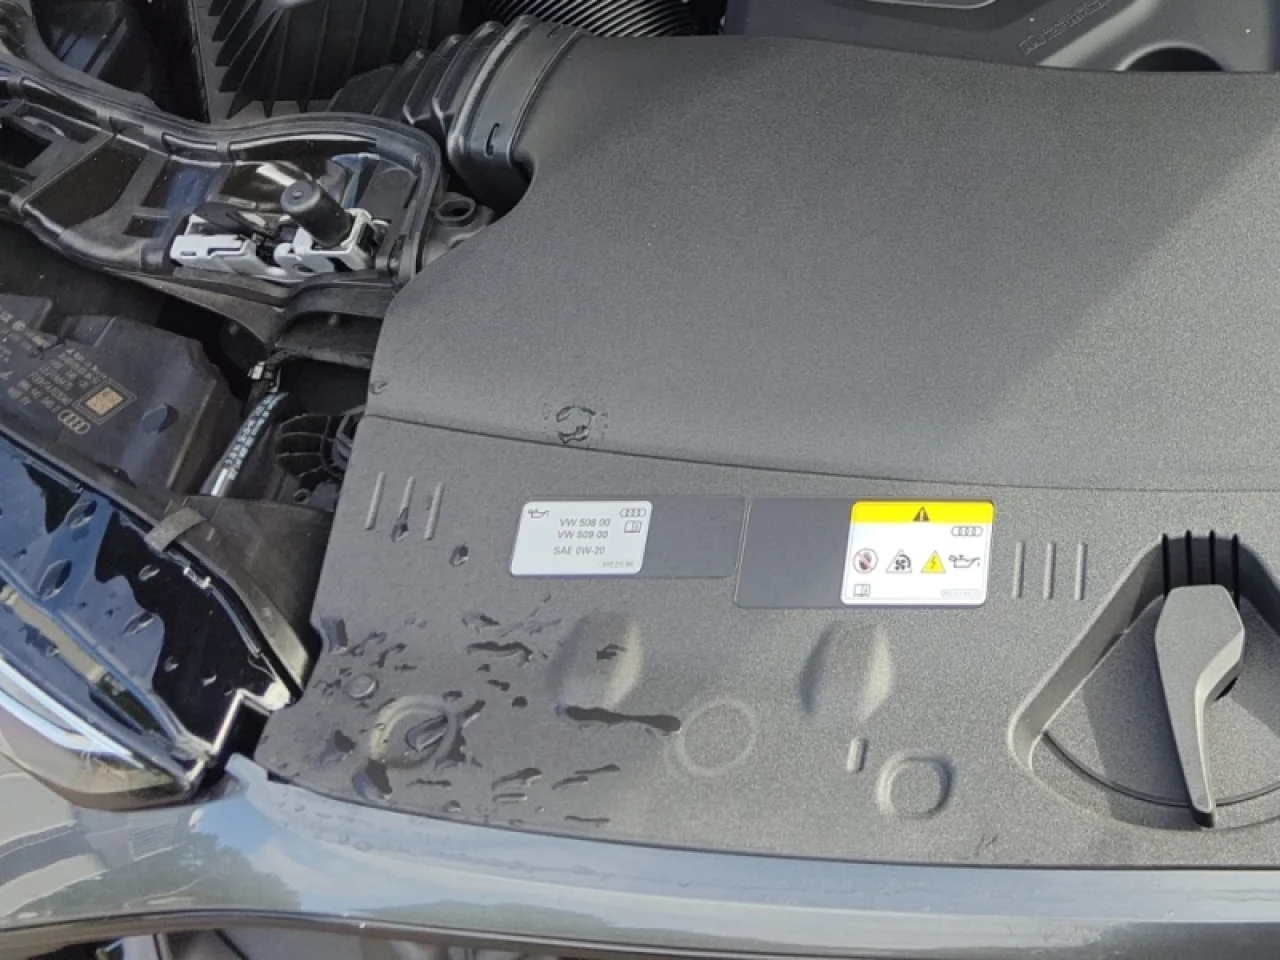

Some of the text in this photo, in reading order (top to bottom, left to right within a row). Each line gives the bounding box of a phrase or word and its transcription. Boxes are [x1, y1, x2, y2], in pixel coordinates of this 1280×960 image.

[559, 518, 611, 527] VW 508 00
[557, 530, 609, 539] VW 509 00
[553, 546, 606, 556] SAE 0W-20
